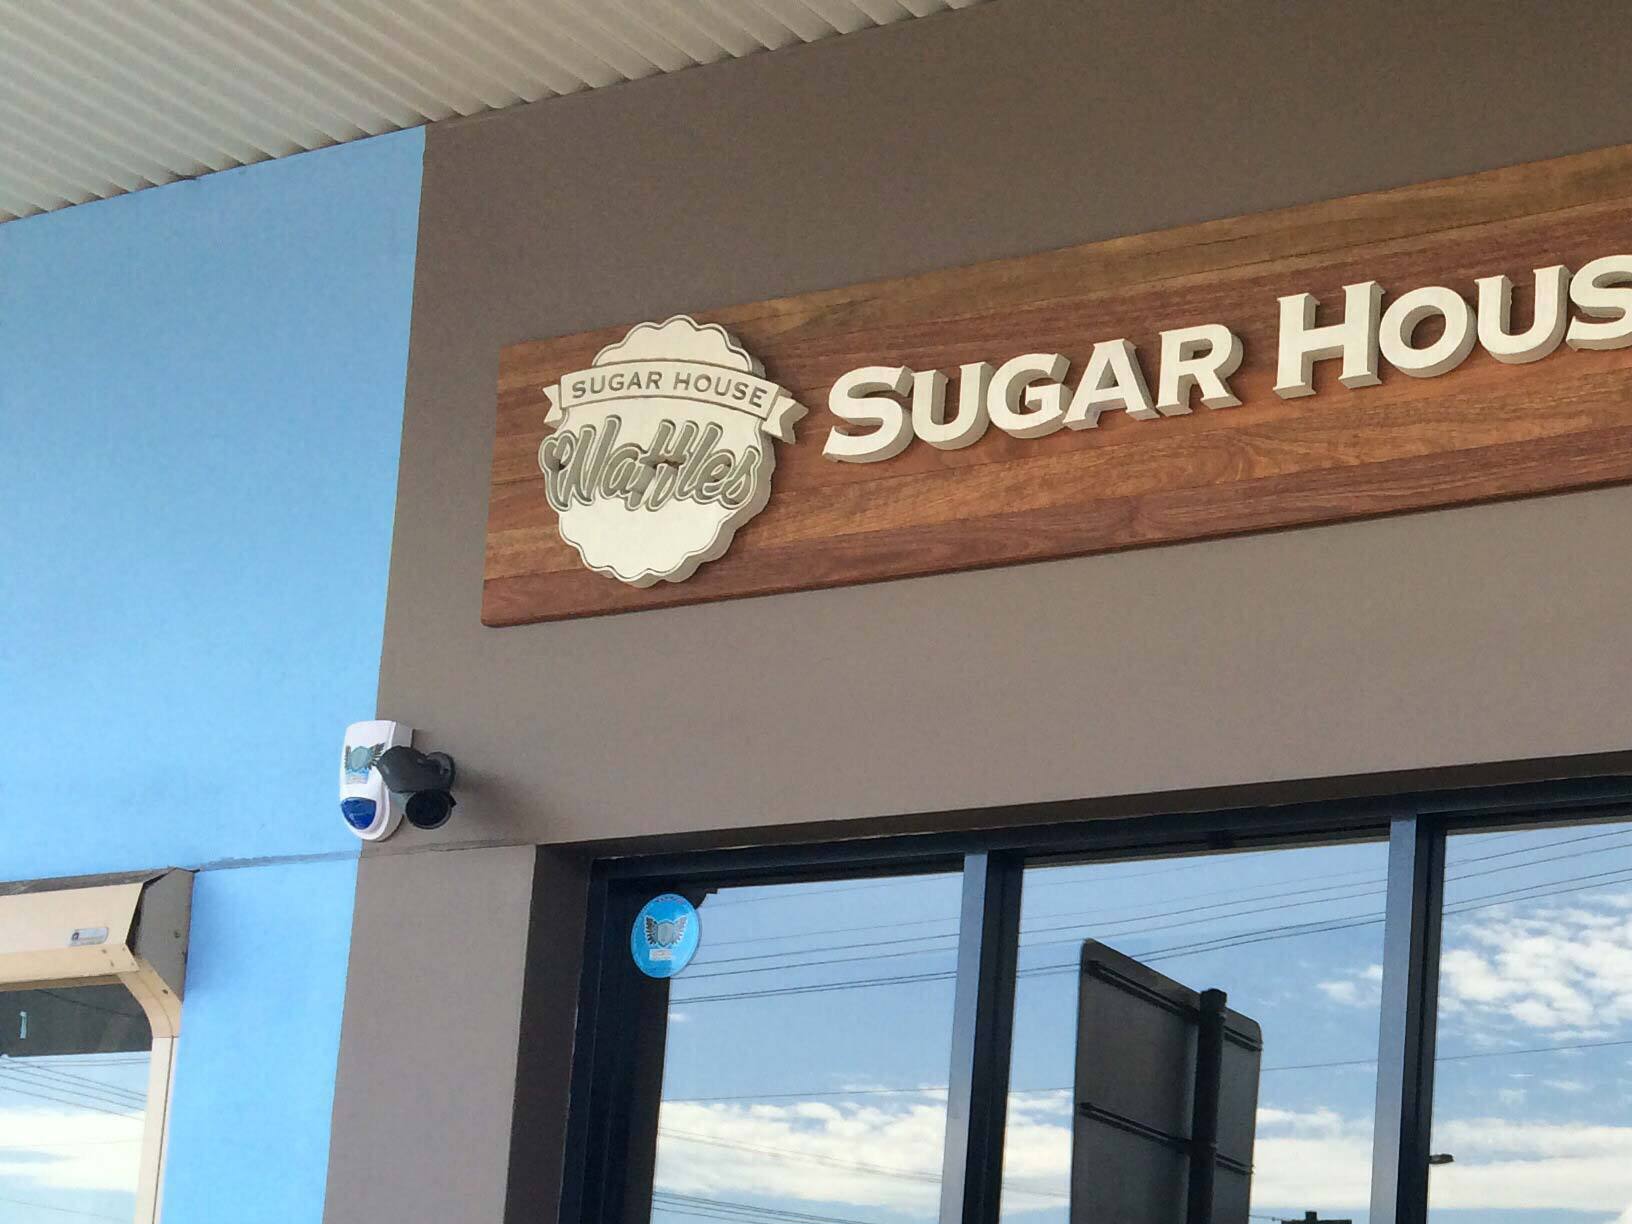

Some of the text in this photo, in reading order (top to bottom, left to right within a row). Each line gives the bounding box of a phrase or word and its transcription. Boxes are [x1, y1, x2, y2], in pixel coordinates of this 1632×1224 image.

[572, 371, 768, 409] SUGAR HOUSE
[824, 324, 1243, 462] SUGAR
[539, 415, 761, 512] Waffles
